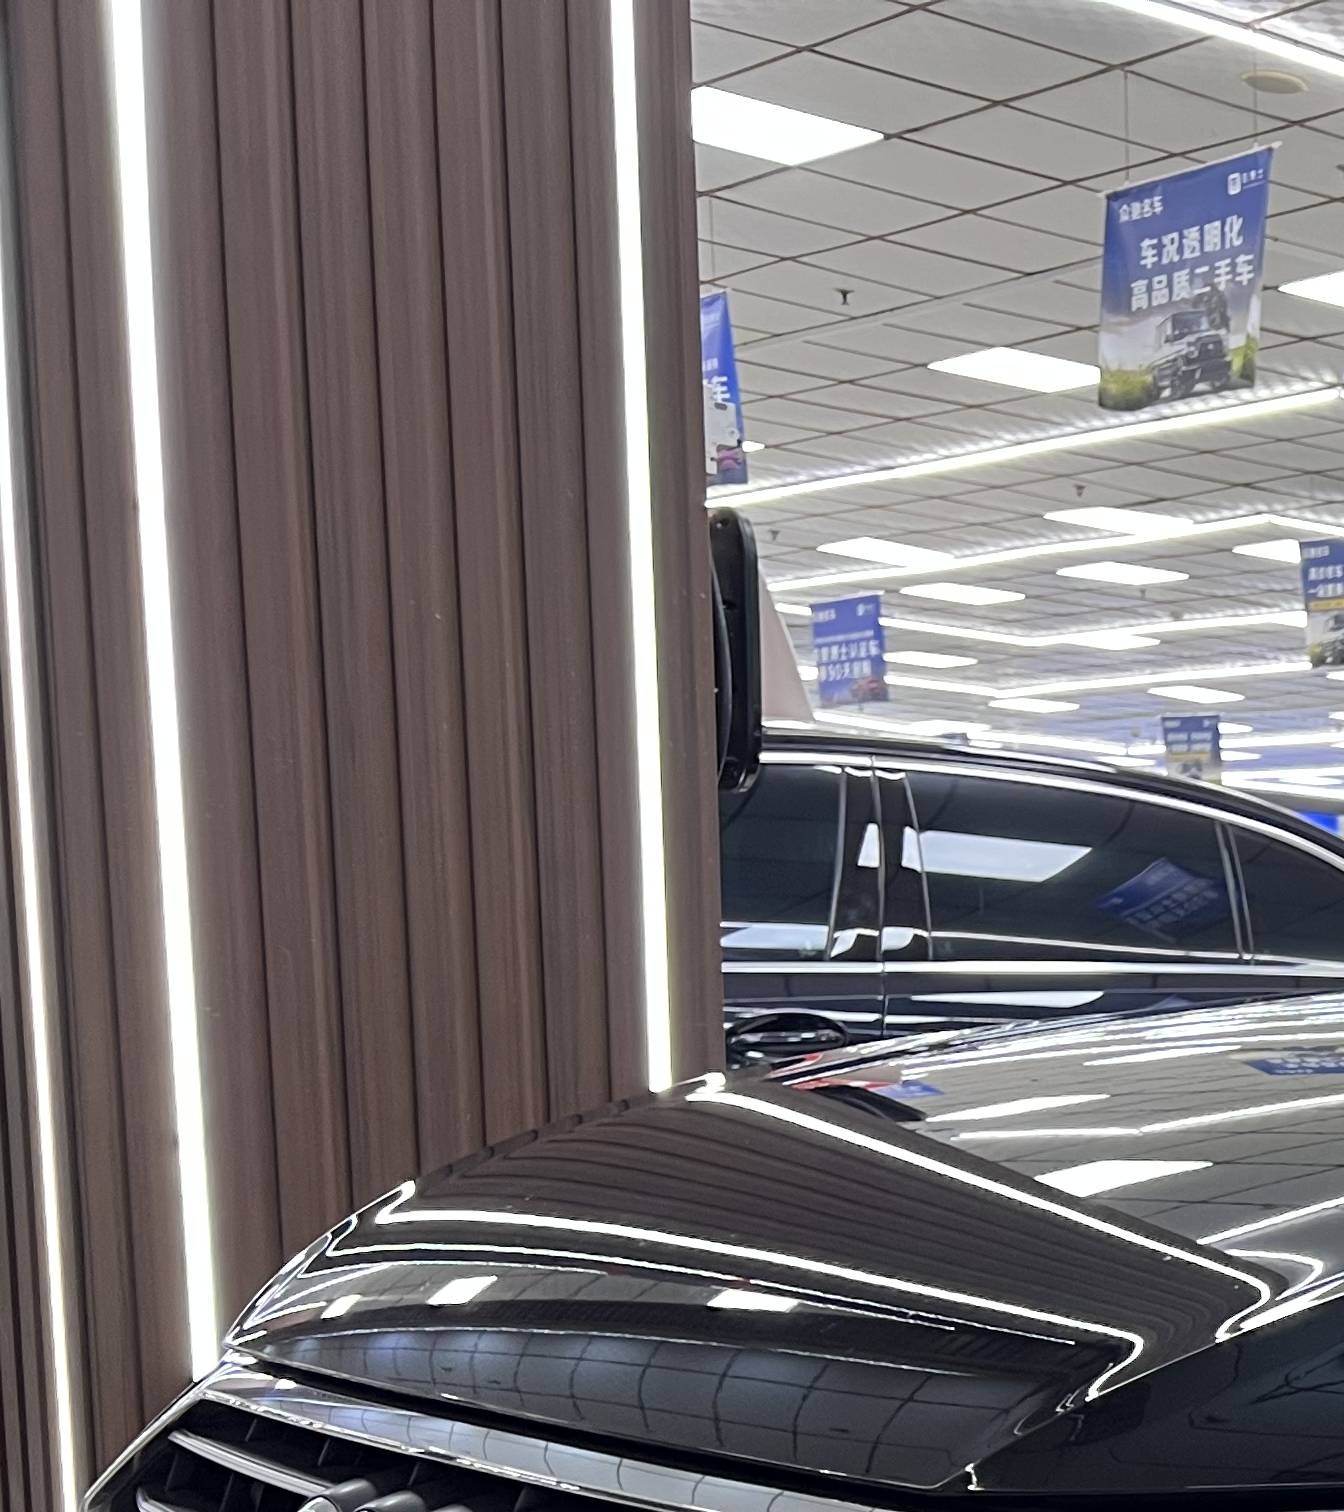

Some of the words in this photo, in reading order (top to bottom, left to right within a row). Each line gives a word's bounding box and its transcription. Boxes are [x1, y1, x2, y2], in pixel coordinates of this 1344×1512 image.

[1139, 214, 1244, 270] 车况透明化
[1130, 253, 1255, 313] 高品质二手车
